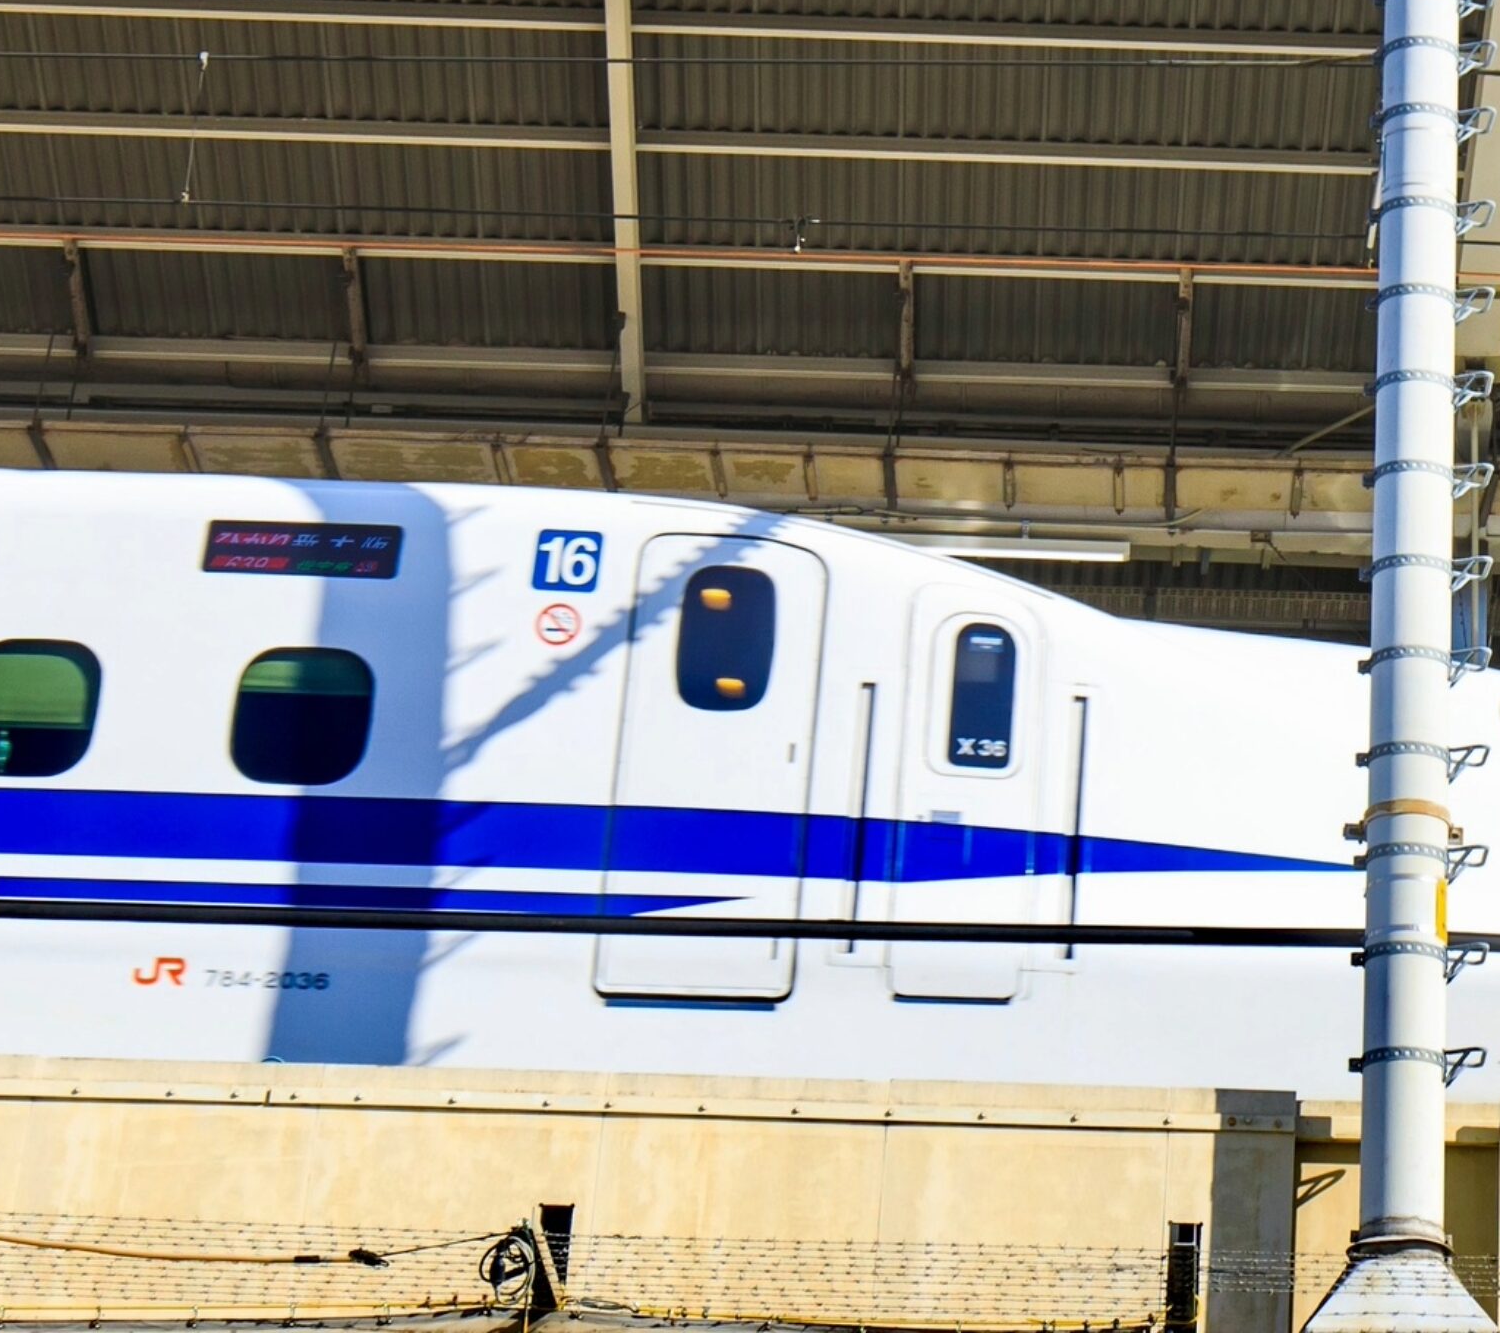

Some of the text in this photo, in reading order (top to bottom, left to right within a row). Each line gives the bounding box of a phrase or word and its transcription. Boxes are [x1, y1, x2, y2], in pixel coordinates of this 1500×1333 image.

[539, 536, 598, 585] 16
[134, 957, 184, 985] JR
[204, 969, 330, 990] 784-2036
